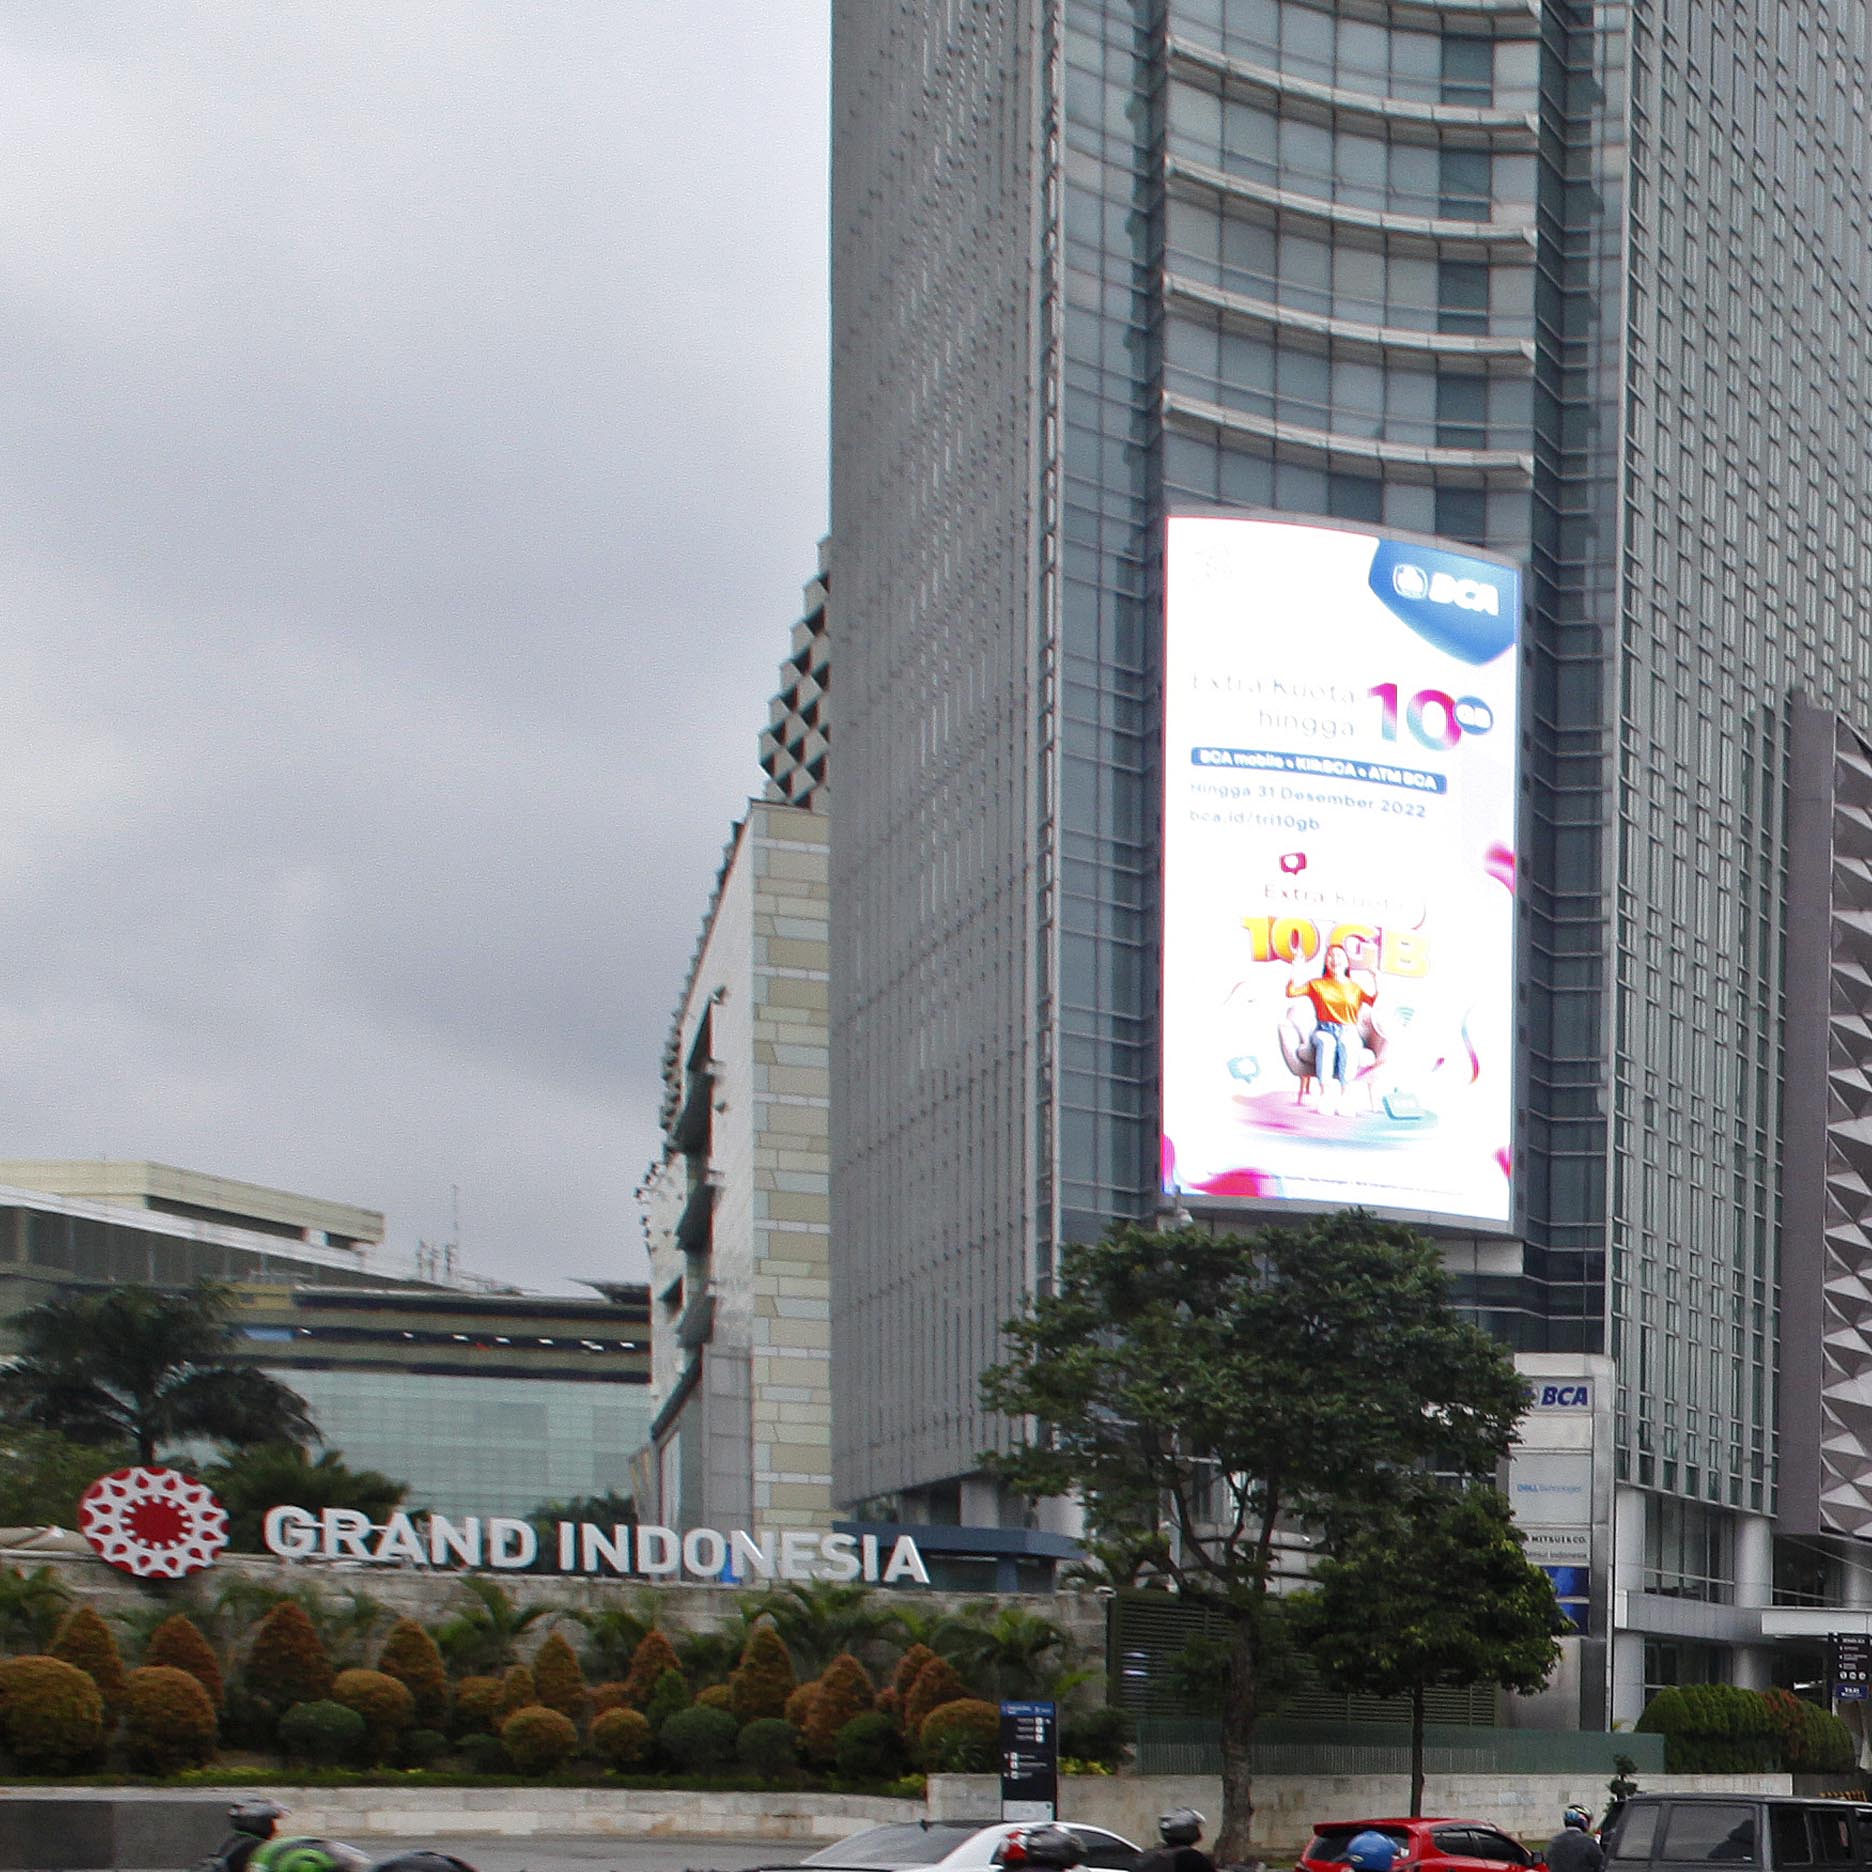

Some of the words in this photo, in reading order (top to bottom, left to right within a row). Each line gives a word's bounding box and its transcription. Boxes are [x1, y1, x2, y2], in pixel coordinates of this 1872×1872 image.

[1429, 571, 1499, 616] BCA
[1258, 709, 1355, 740] hingga
[1366, 682, 1462, 751] 10
[1402, 770, 1438, 790] BCA
[1258, 785, 1275, 798] 31
[1281, 786, 1375, 809] Desember
[1381, 799, 1426, 818] 2022
[1241, 916, 1321, 964] 10
[1541, 1386, 1588, 1406] BCA
[264, 1505, 539, 1569] GRAND
[558, 1520, 932, 1584] INDONESIA
